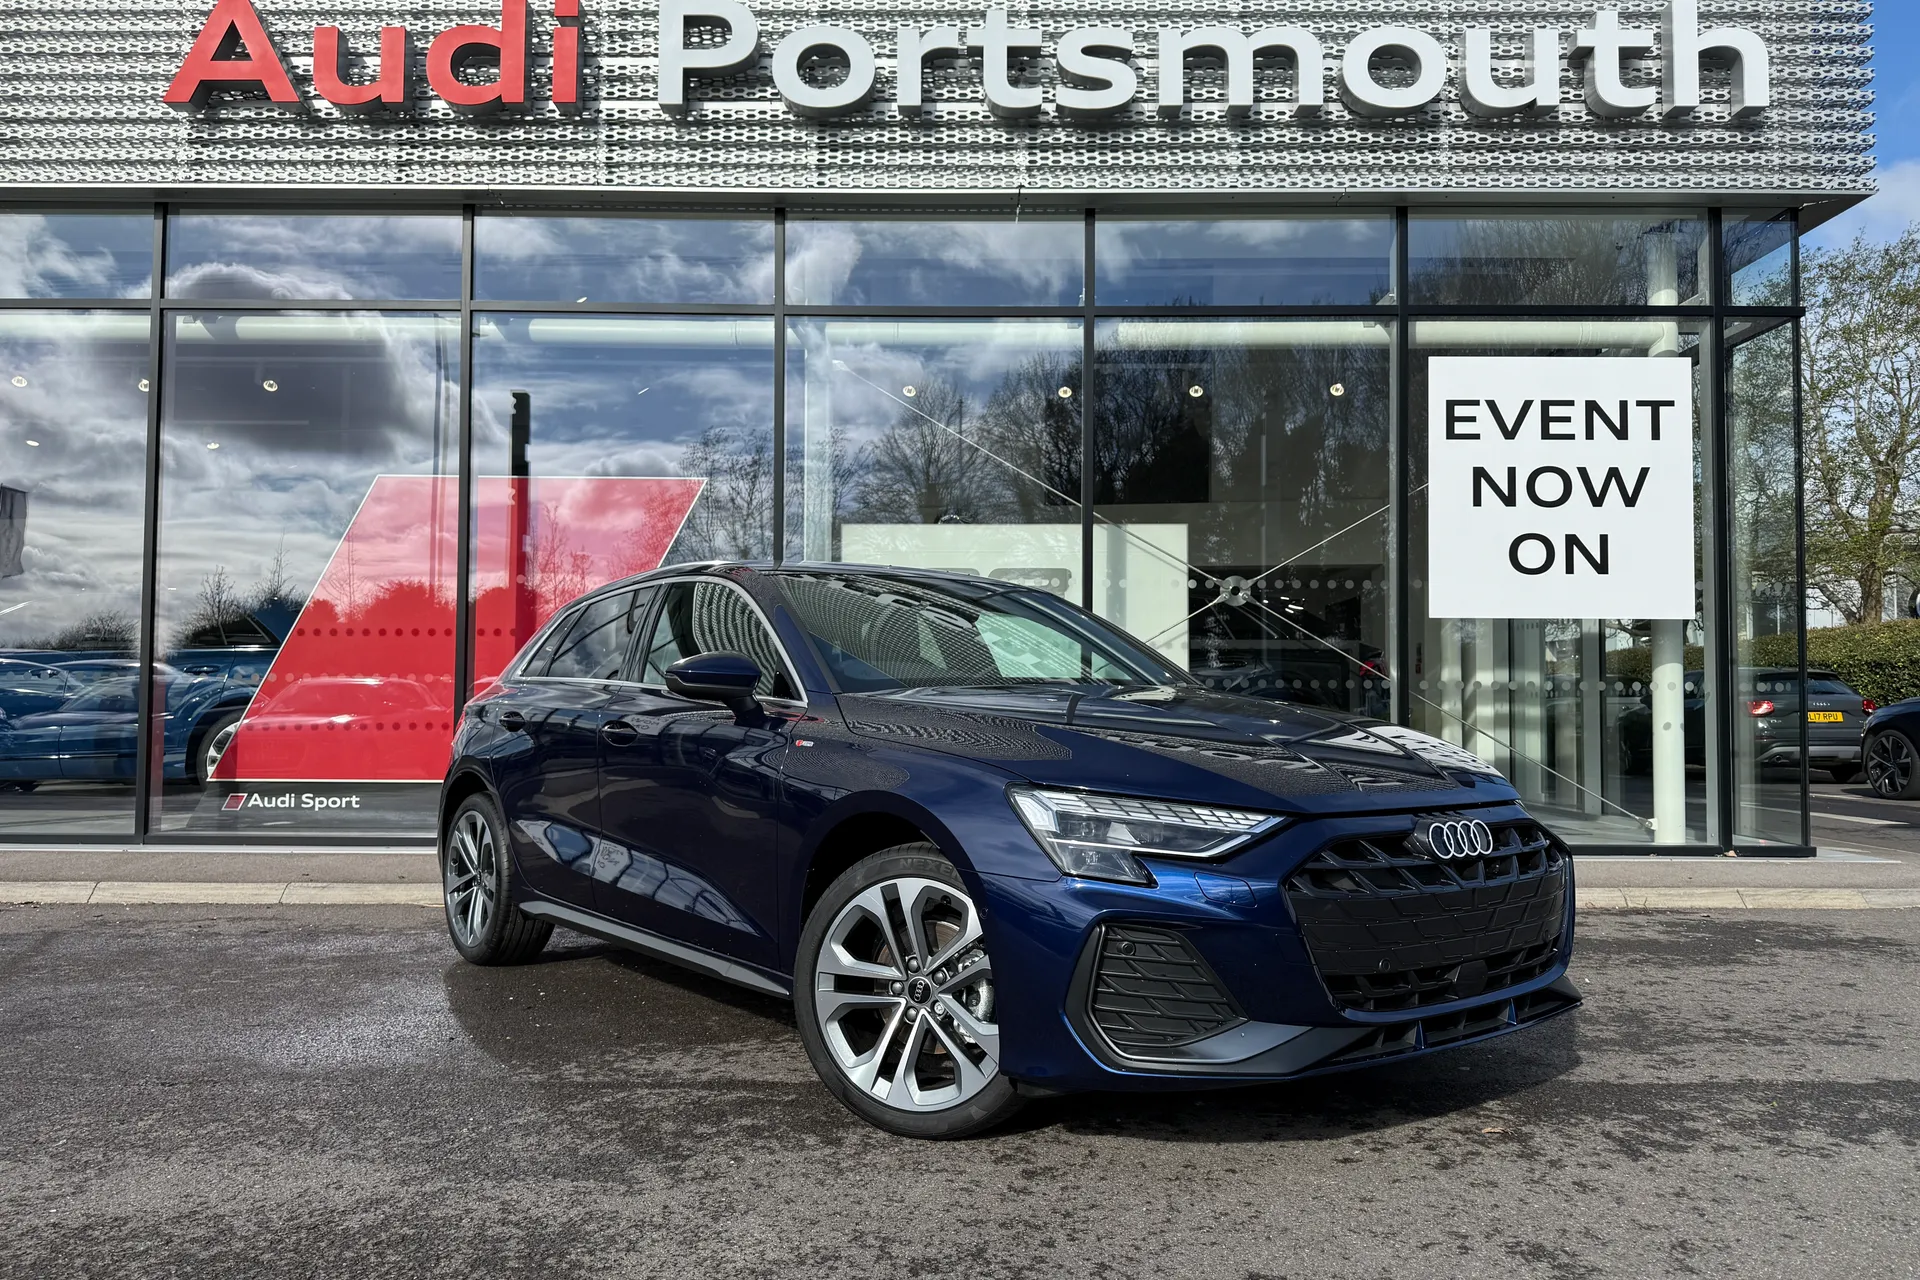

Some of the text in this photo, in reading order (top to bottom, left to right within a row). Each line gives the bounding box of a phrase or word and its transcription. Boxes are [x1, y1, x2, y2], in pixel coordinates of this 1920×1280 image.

[163, 0, 1770, 110] Audi Portsmouth
[1445, 399, 1675, 441] EVENT
[1472, 465, 1651, 508] NOW
[1508, 532, 1609, 576] ON
[247, 793, 360, 811] Audi Sport
